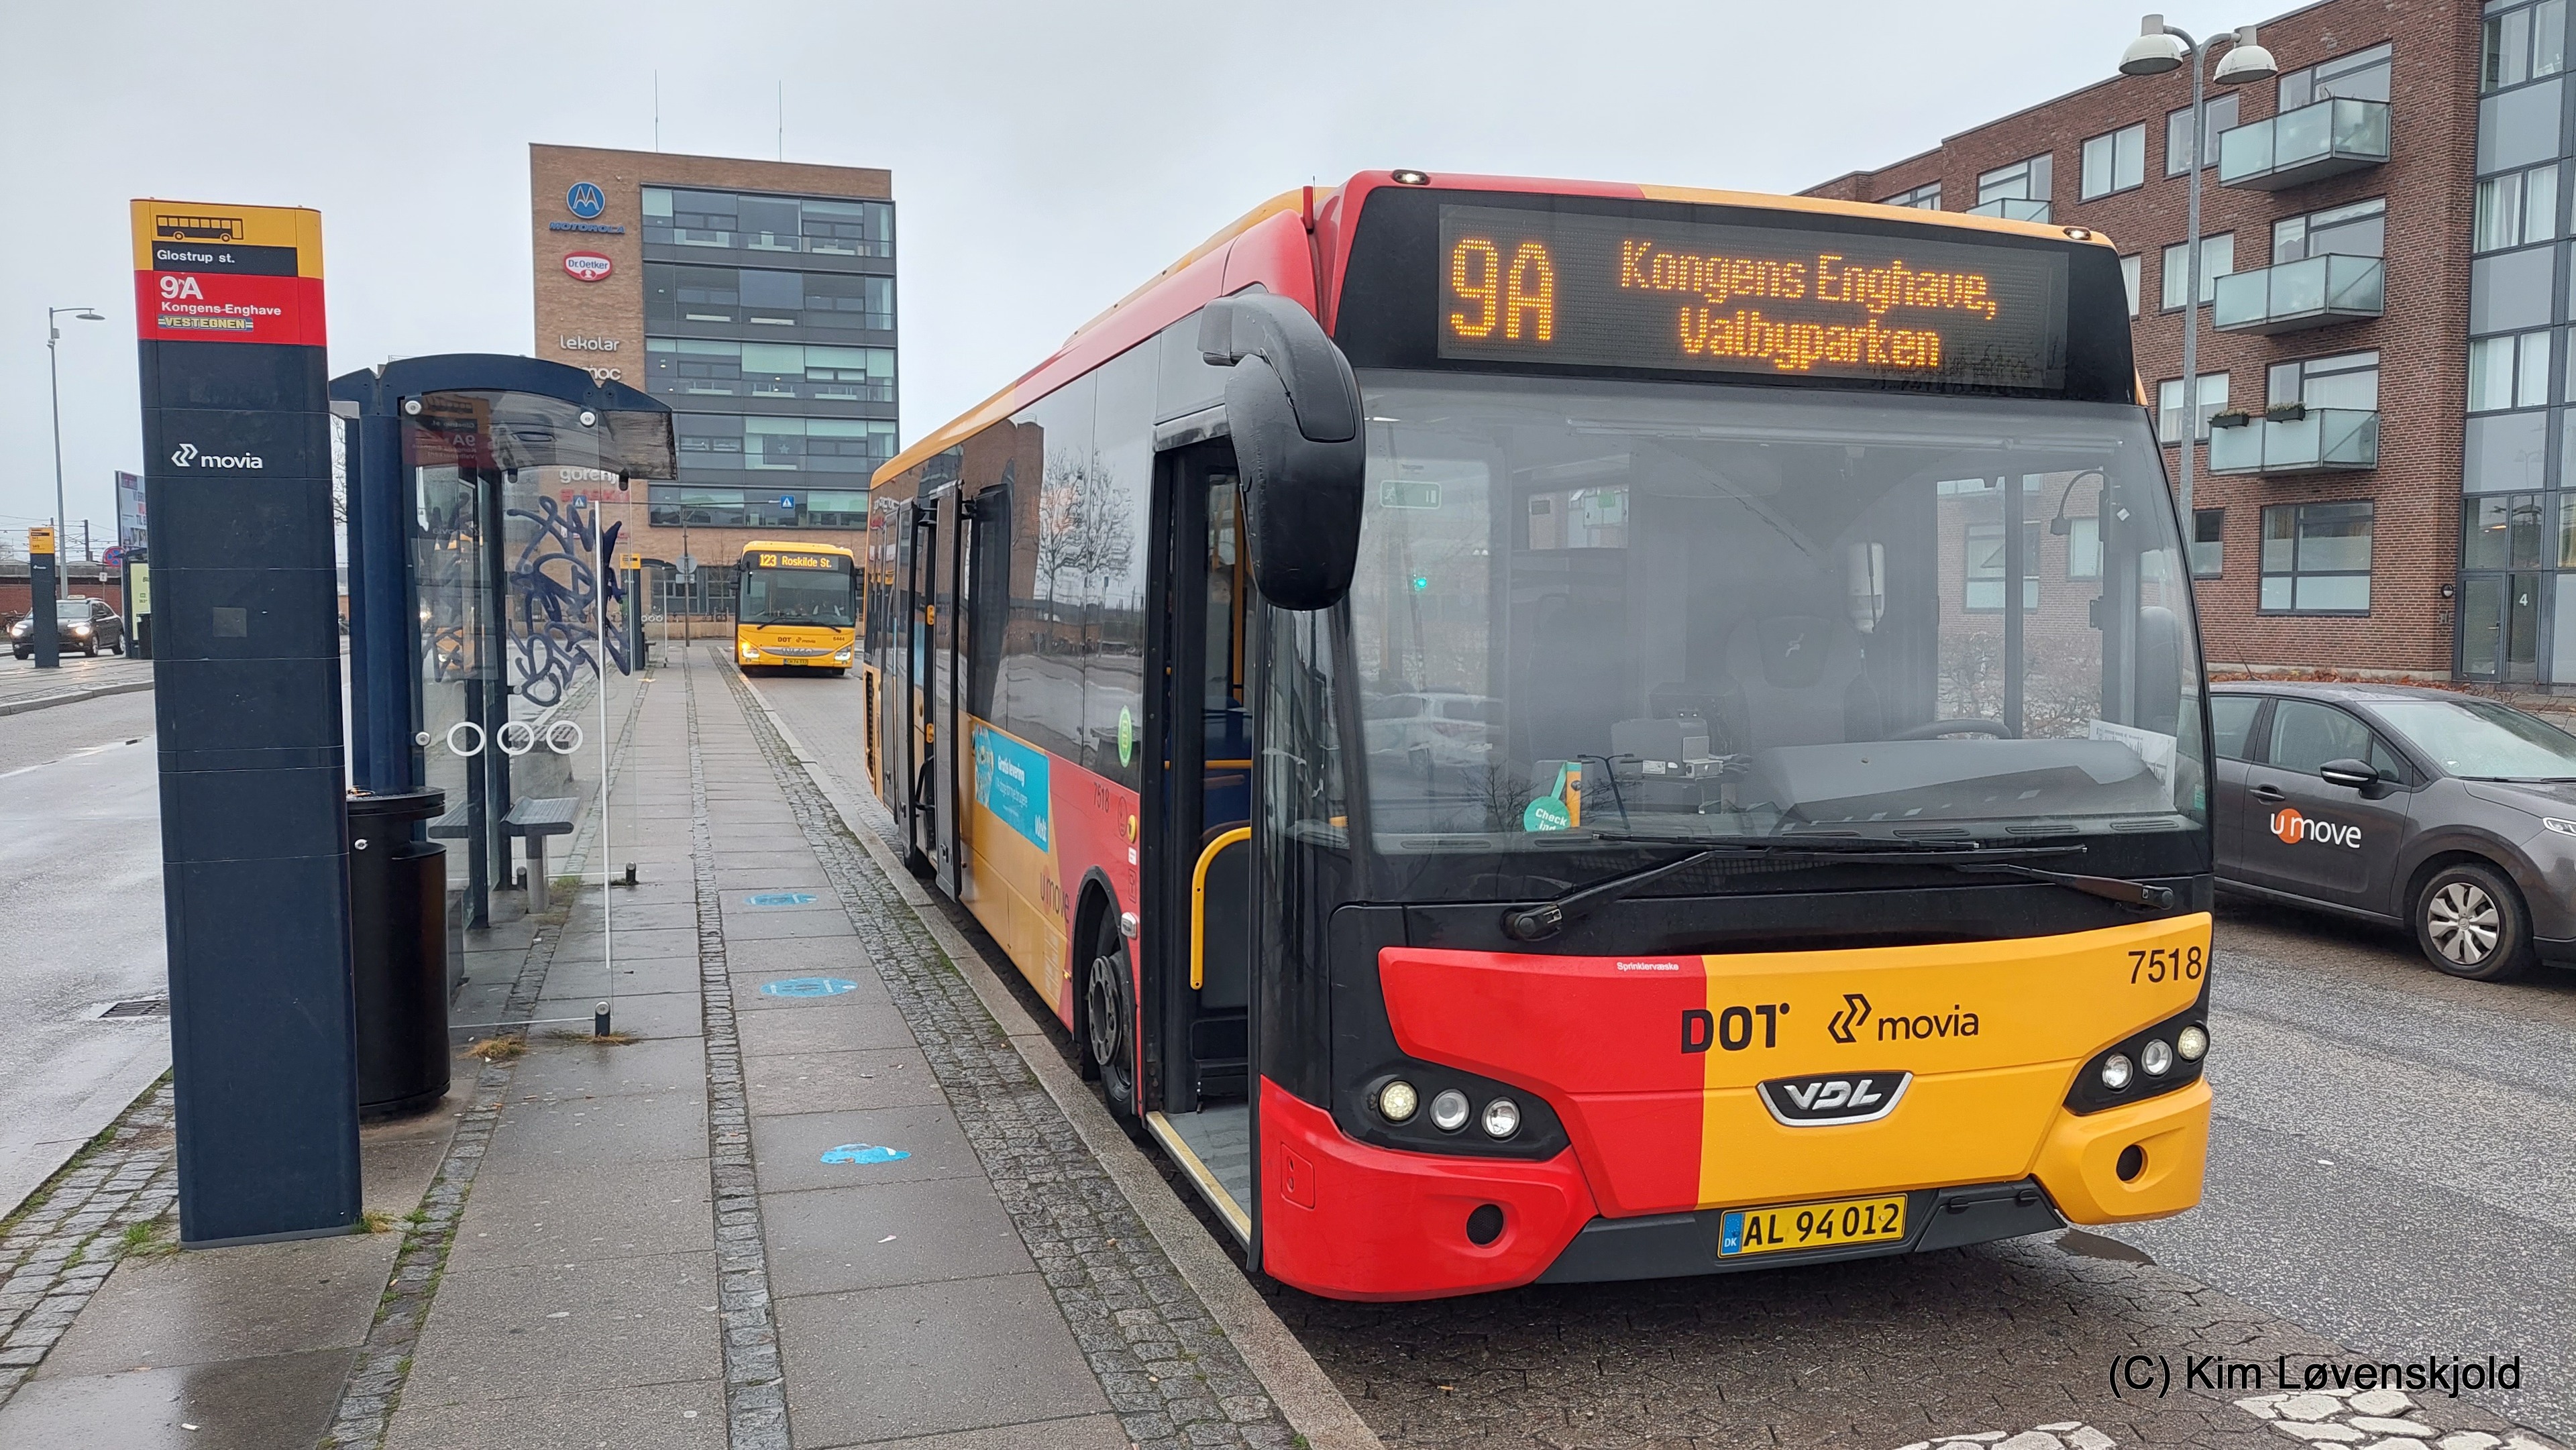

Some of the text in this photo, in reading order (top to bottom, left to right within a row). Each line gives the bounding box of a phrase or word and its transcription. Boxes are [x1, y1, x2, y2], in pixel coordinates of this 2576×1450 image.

[549, 222, 625, 234] MOTOROLA
[156, 249, 235, 264] Glostrup st.
[160, 276, 204, 300] 9A
[1450, 237, 1554, 341] 9A
[1620, 239, 1998, 321] Kongens Enghave,
[164, 317, 246, 329] VESTEGNEN
[559, 334, 621, 351] lekolar
[1679, 306, 1941, 371] Valbyparken
[200, 452, 263, 469] movia
[559, 469, 620, 484] gorenj
[759, 554, 832, 568] 123 Roskilde St.
[2519, 593, 2528, 606] 4
[1093, 782, 1110, 813] 7518
[1535, 807, 1568, 826] Check
[1035, 814, 1046, 842] Wolt
[2270, 813, 2362, 848] umove
[1617, 962, 1679, 972] Sprinklervæske
[2127, 946, 2203, 984] 7518
[1681, 1003, 1980, 1054] DOT movia
[1784, 1080, 1882, 1110] VDL
[1743, 1214, 1784, 1246] AL
[1724, 1237, 1737, 1247] DK
